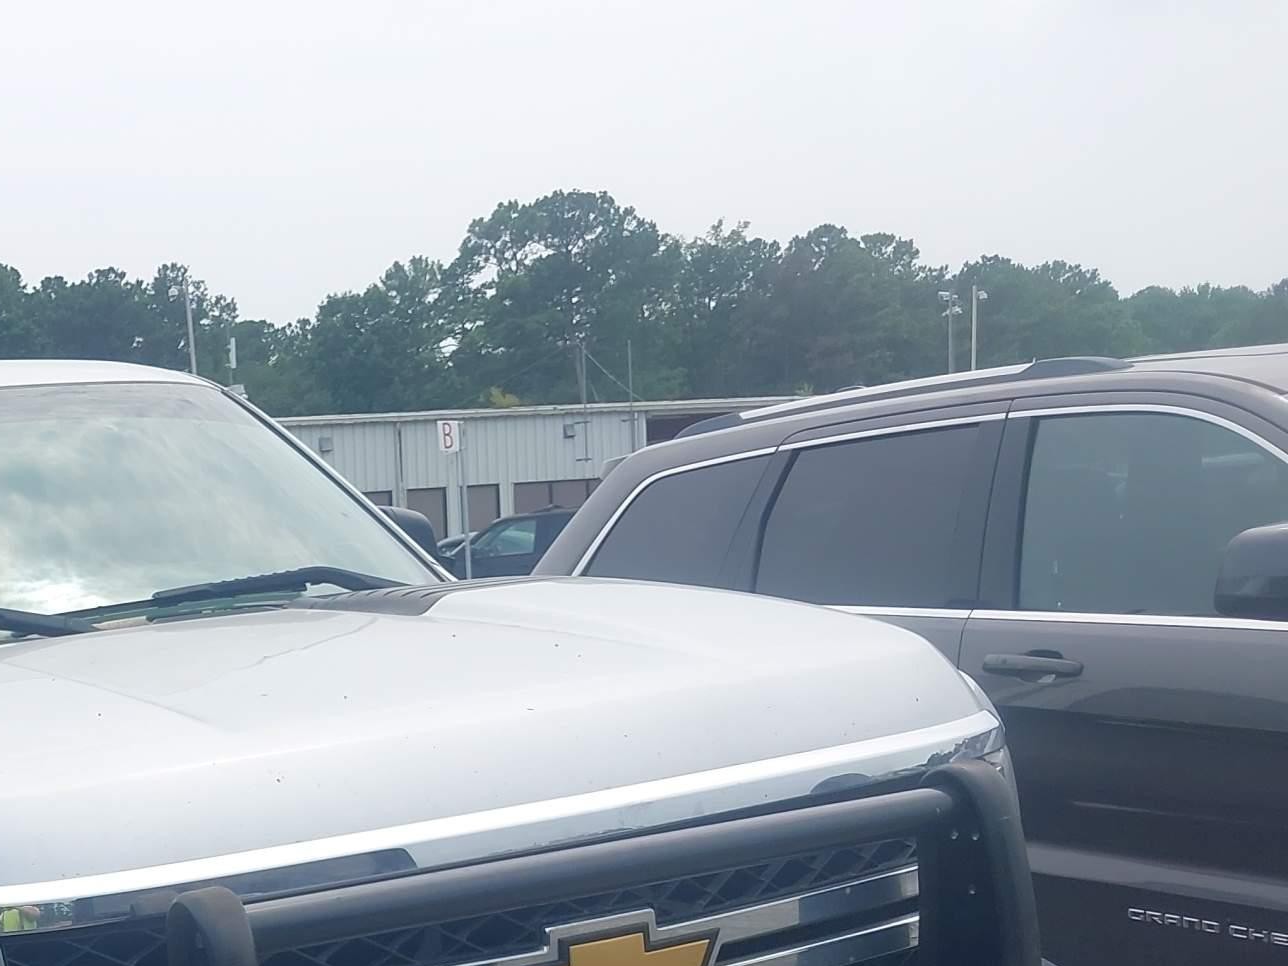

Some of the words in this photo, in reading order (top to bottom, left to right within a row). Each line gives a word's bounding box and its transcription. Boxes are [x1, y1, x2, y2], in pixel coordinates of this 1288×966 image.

[442, 422, 454, 449] B
[1127, 907, 1221, 933] GRAND
[1228, 924, 1288, 946] CHE
